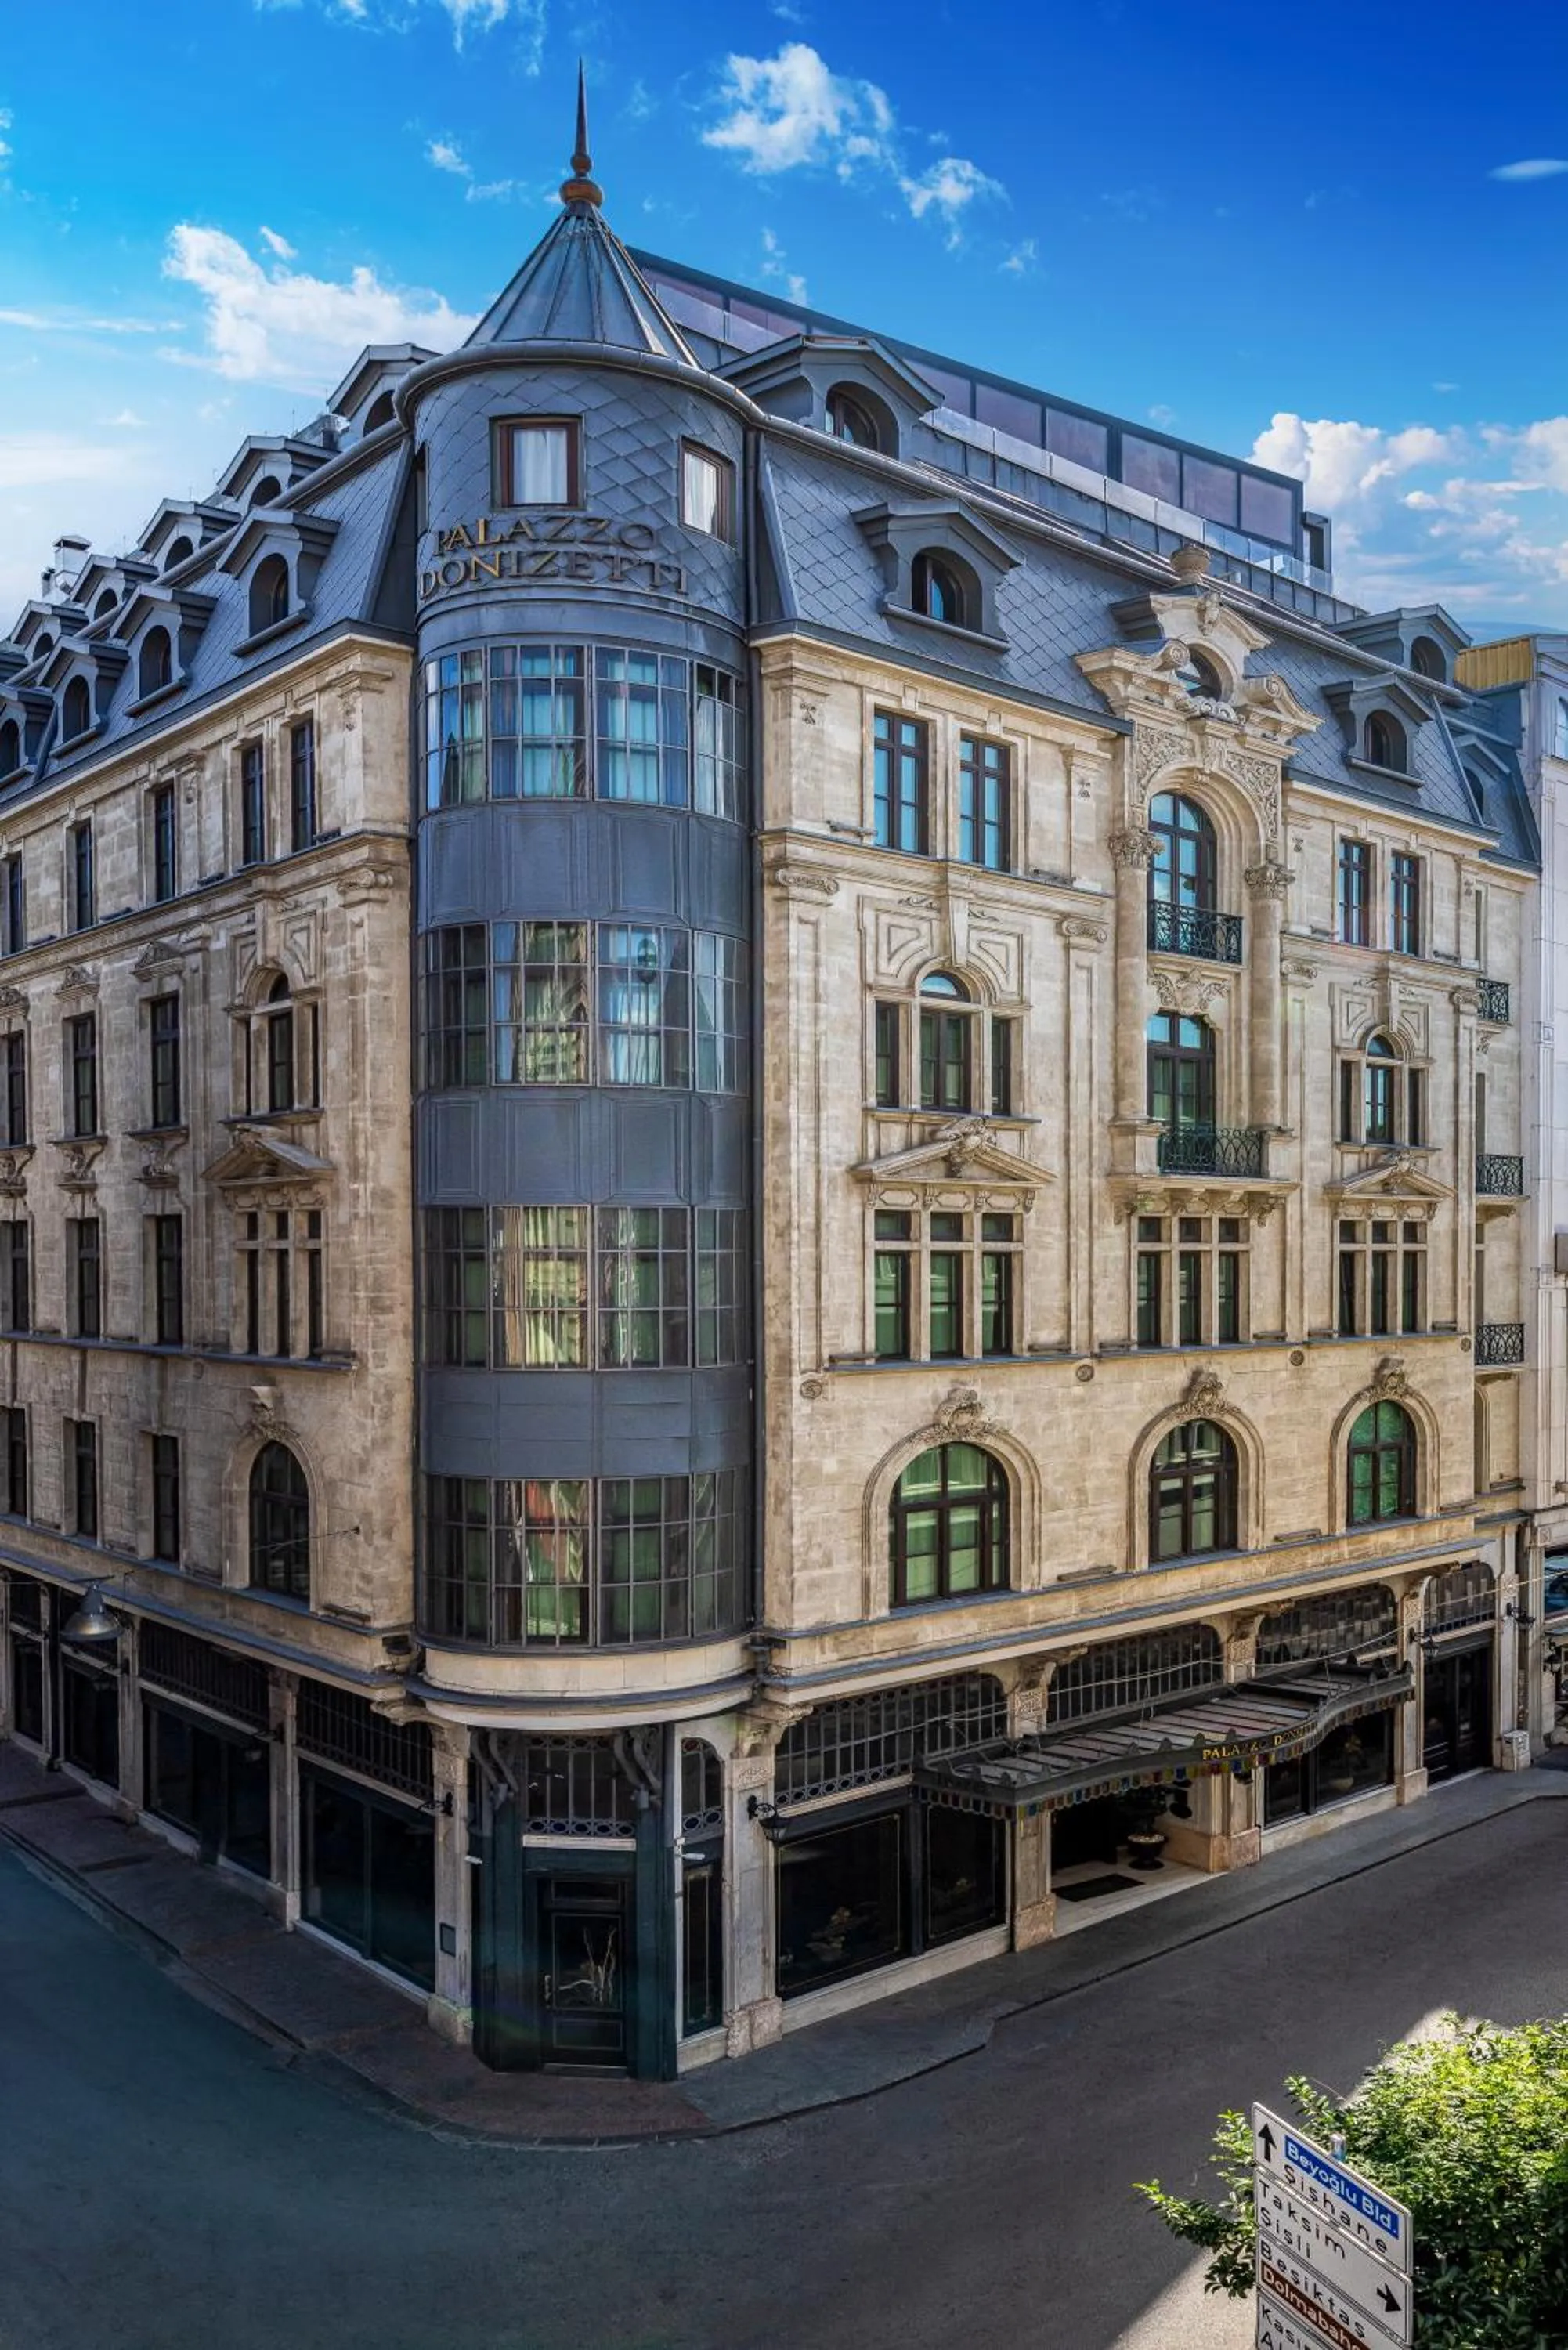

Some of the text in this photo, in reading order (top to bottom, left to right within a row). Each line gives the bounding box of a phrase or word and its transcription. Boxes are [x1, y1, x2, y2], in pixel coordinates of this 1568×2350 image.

[433, 515, 657, 556] PALAZZO
[418, 550, 690, 600] DONIZETTI
[1202, 1733, 1268, 1760] PALAZ
[1287, 2141, 1396, 2234] Beyoğlu Bld.
[1259, 2180, 1346, 2259] Taksim
